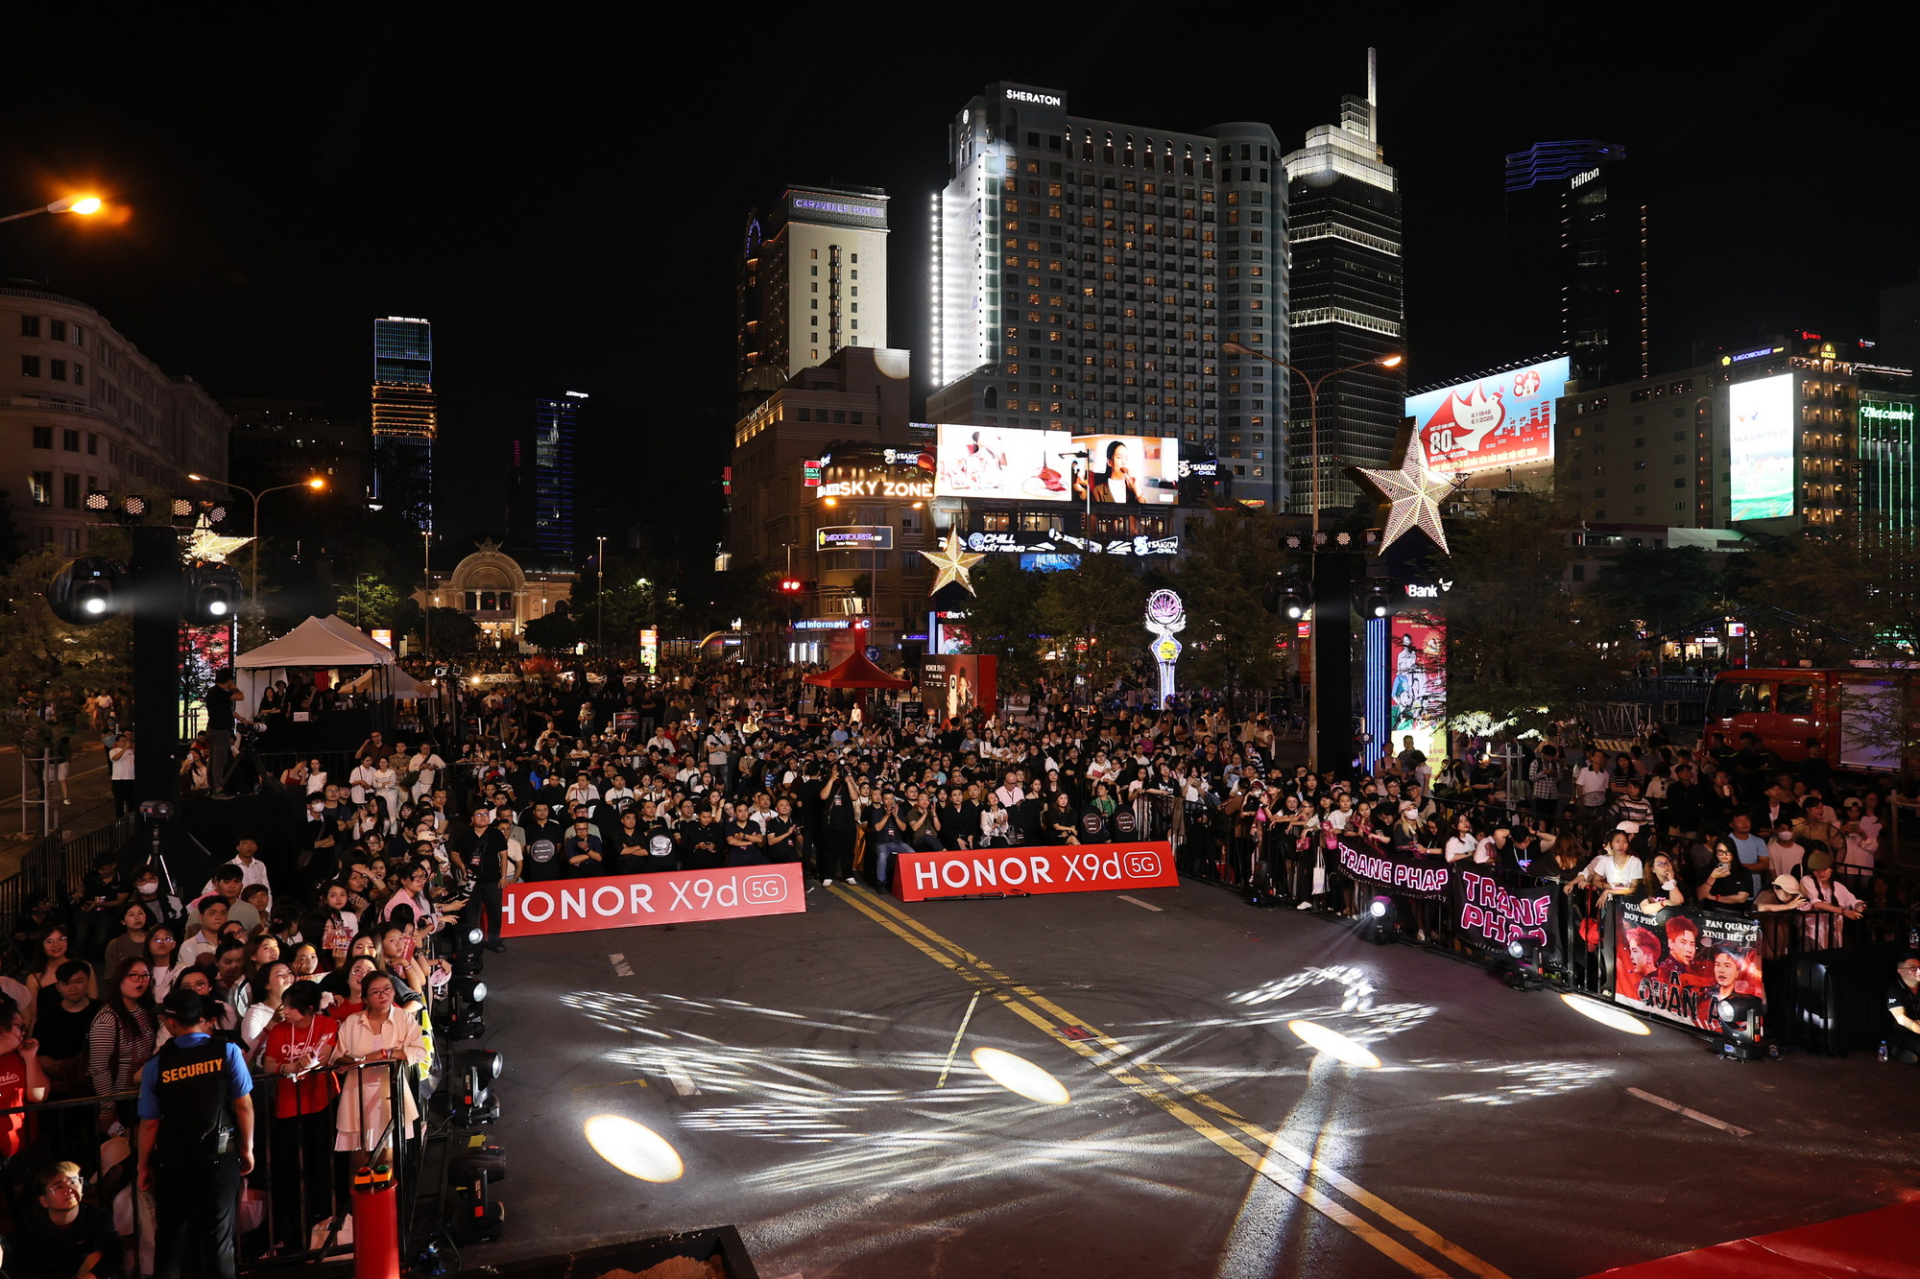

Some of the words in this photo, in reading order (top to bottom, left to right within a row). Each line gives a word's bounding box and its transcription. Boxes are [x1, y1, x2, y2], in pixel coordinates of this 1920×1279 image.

[1006, 89, 1061, 106] SHERATON
[1571, 167, 1599, 189] Hilton
[795, 199, 848, 212] CARAVELLE
[852, 206, 881, 216] HOTEL
[1732, 348, 1772, 361] SAIGONTOURIST
[1429, 429, 1452, 455] 80
[839, 480, 878, 496] SKY
[883, 482, 934, 497] ZONE
[983, 533, 1016, 544] CHILL
[1149, 540, 1178, 549] SAIGON
[914, 856, 1055, 890] HONOR
[1061, 851, 1122, 882] X9d
[1131, 857, 1155, 873] 5G
[1338, 842, 1393, 883] TRANG
[1394, 864, 1449, 891] PHAP
[668, 875, 738, 912] X9d
[751, 879, 779, 898] 5G
[1463, 871, 1551, 926] TRANG
[1623, 911, 1639, 922] BOY
[1705, 919, 1723, 929] FAN
[1724, 922, 1750, 931] QUÂN
[1702, 930, 1724, 940] XINH
[1726, 932, 1743, 942] HẾT
[1638, 970, 1697, 1021] QUÂN
[162, 1058, 223, 1083] SECURITY
